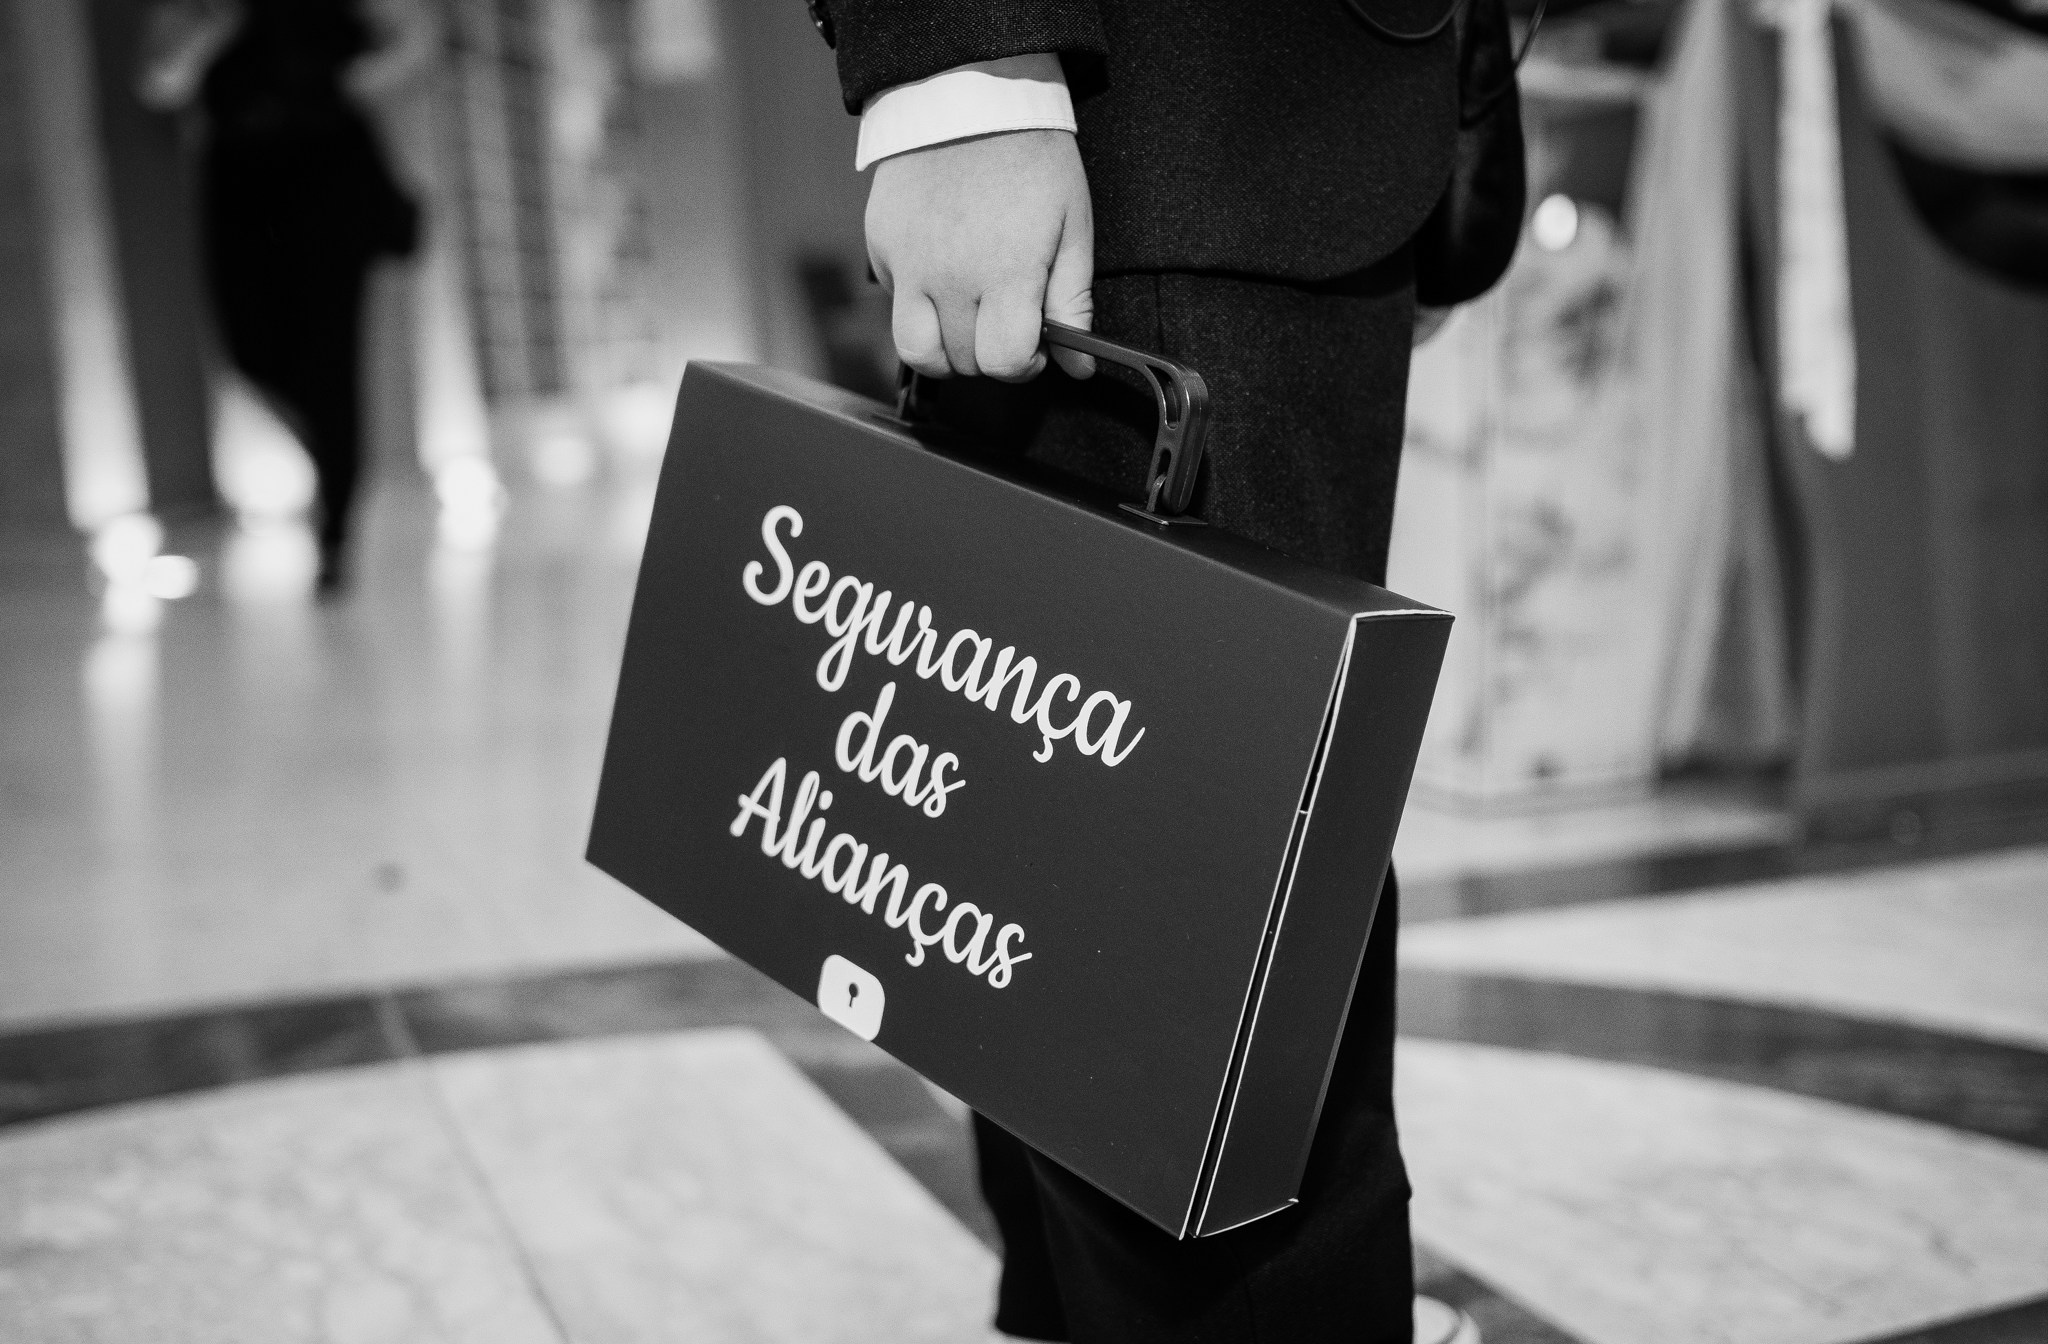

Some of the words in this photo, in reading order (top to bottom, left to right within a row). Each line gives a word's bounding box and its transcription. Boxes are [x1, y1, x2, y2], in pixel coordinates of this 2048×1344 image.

[742, 505, 1146, 767] Segurança
[835, 681, 966, 818] das
[730, 757, 1033, 989] Alianças
